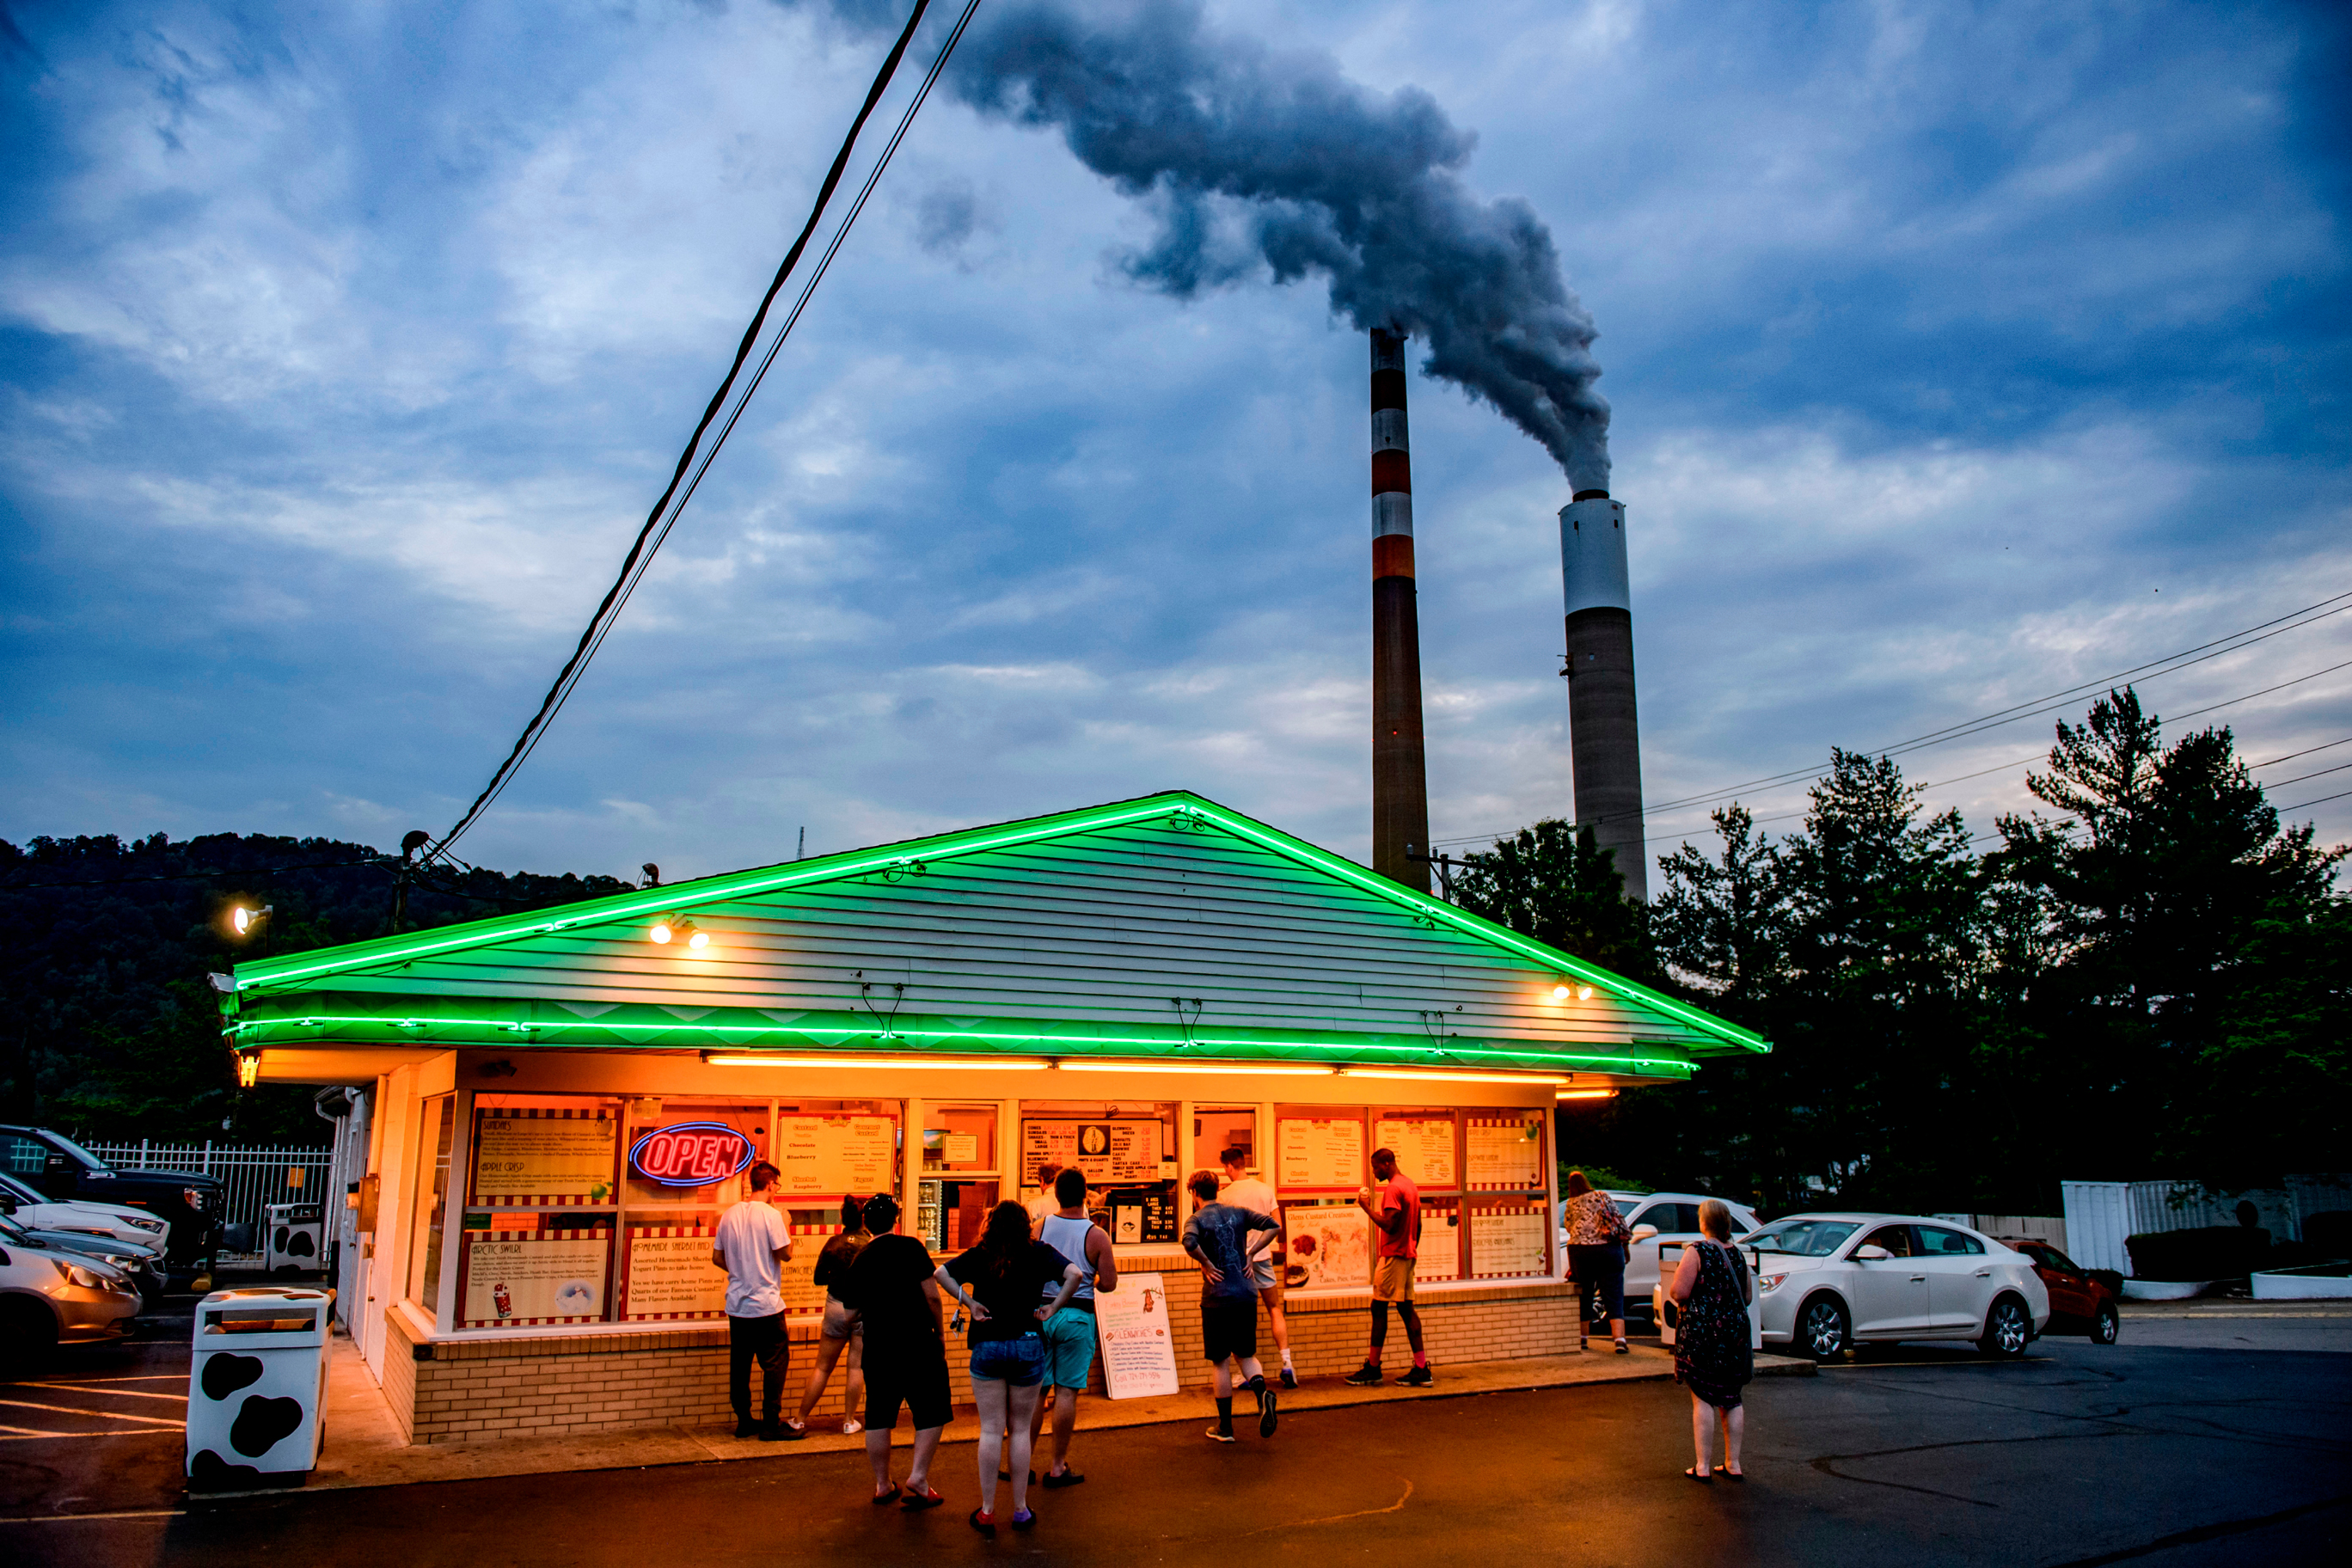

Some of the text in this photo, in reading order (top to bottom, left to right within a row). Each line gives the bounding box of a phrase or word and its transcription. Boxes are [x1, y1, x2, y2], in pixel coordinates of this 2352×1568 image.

[483, 1120, 511, 1131] SUNDAES
[645, 1134, 743, 1177] OPEN
[481, 1162, 524, 1173] APPLE CRISP
[471, 1244, 499, 1255] ARCTIC
[632, 1242, 668, 1253] HOMEMADE
[672, 1242, 695, 1251] SHERBET
[697, 1242, 709, 1251] AND
[1114, 1374, 1127, 1382] Call
